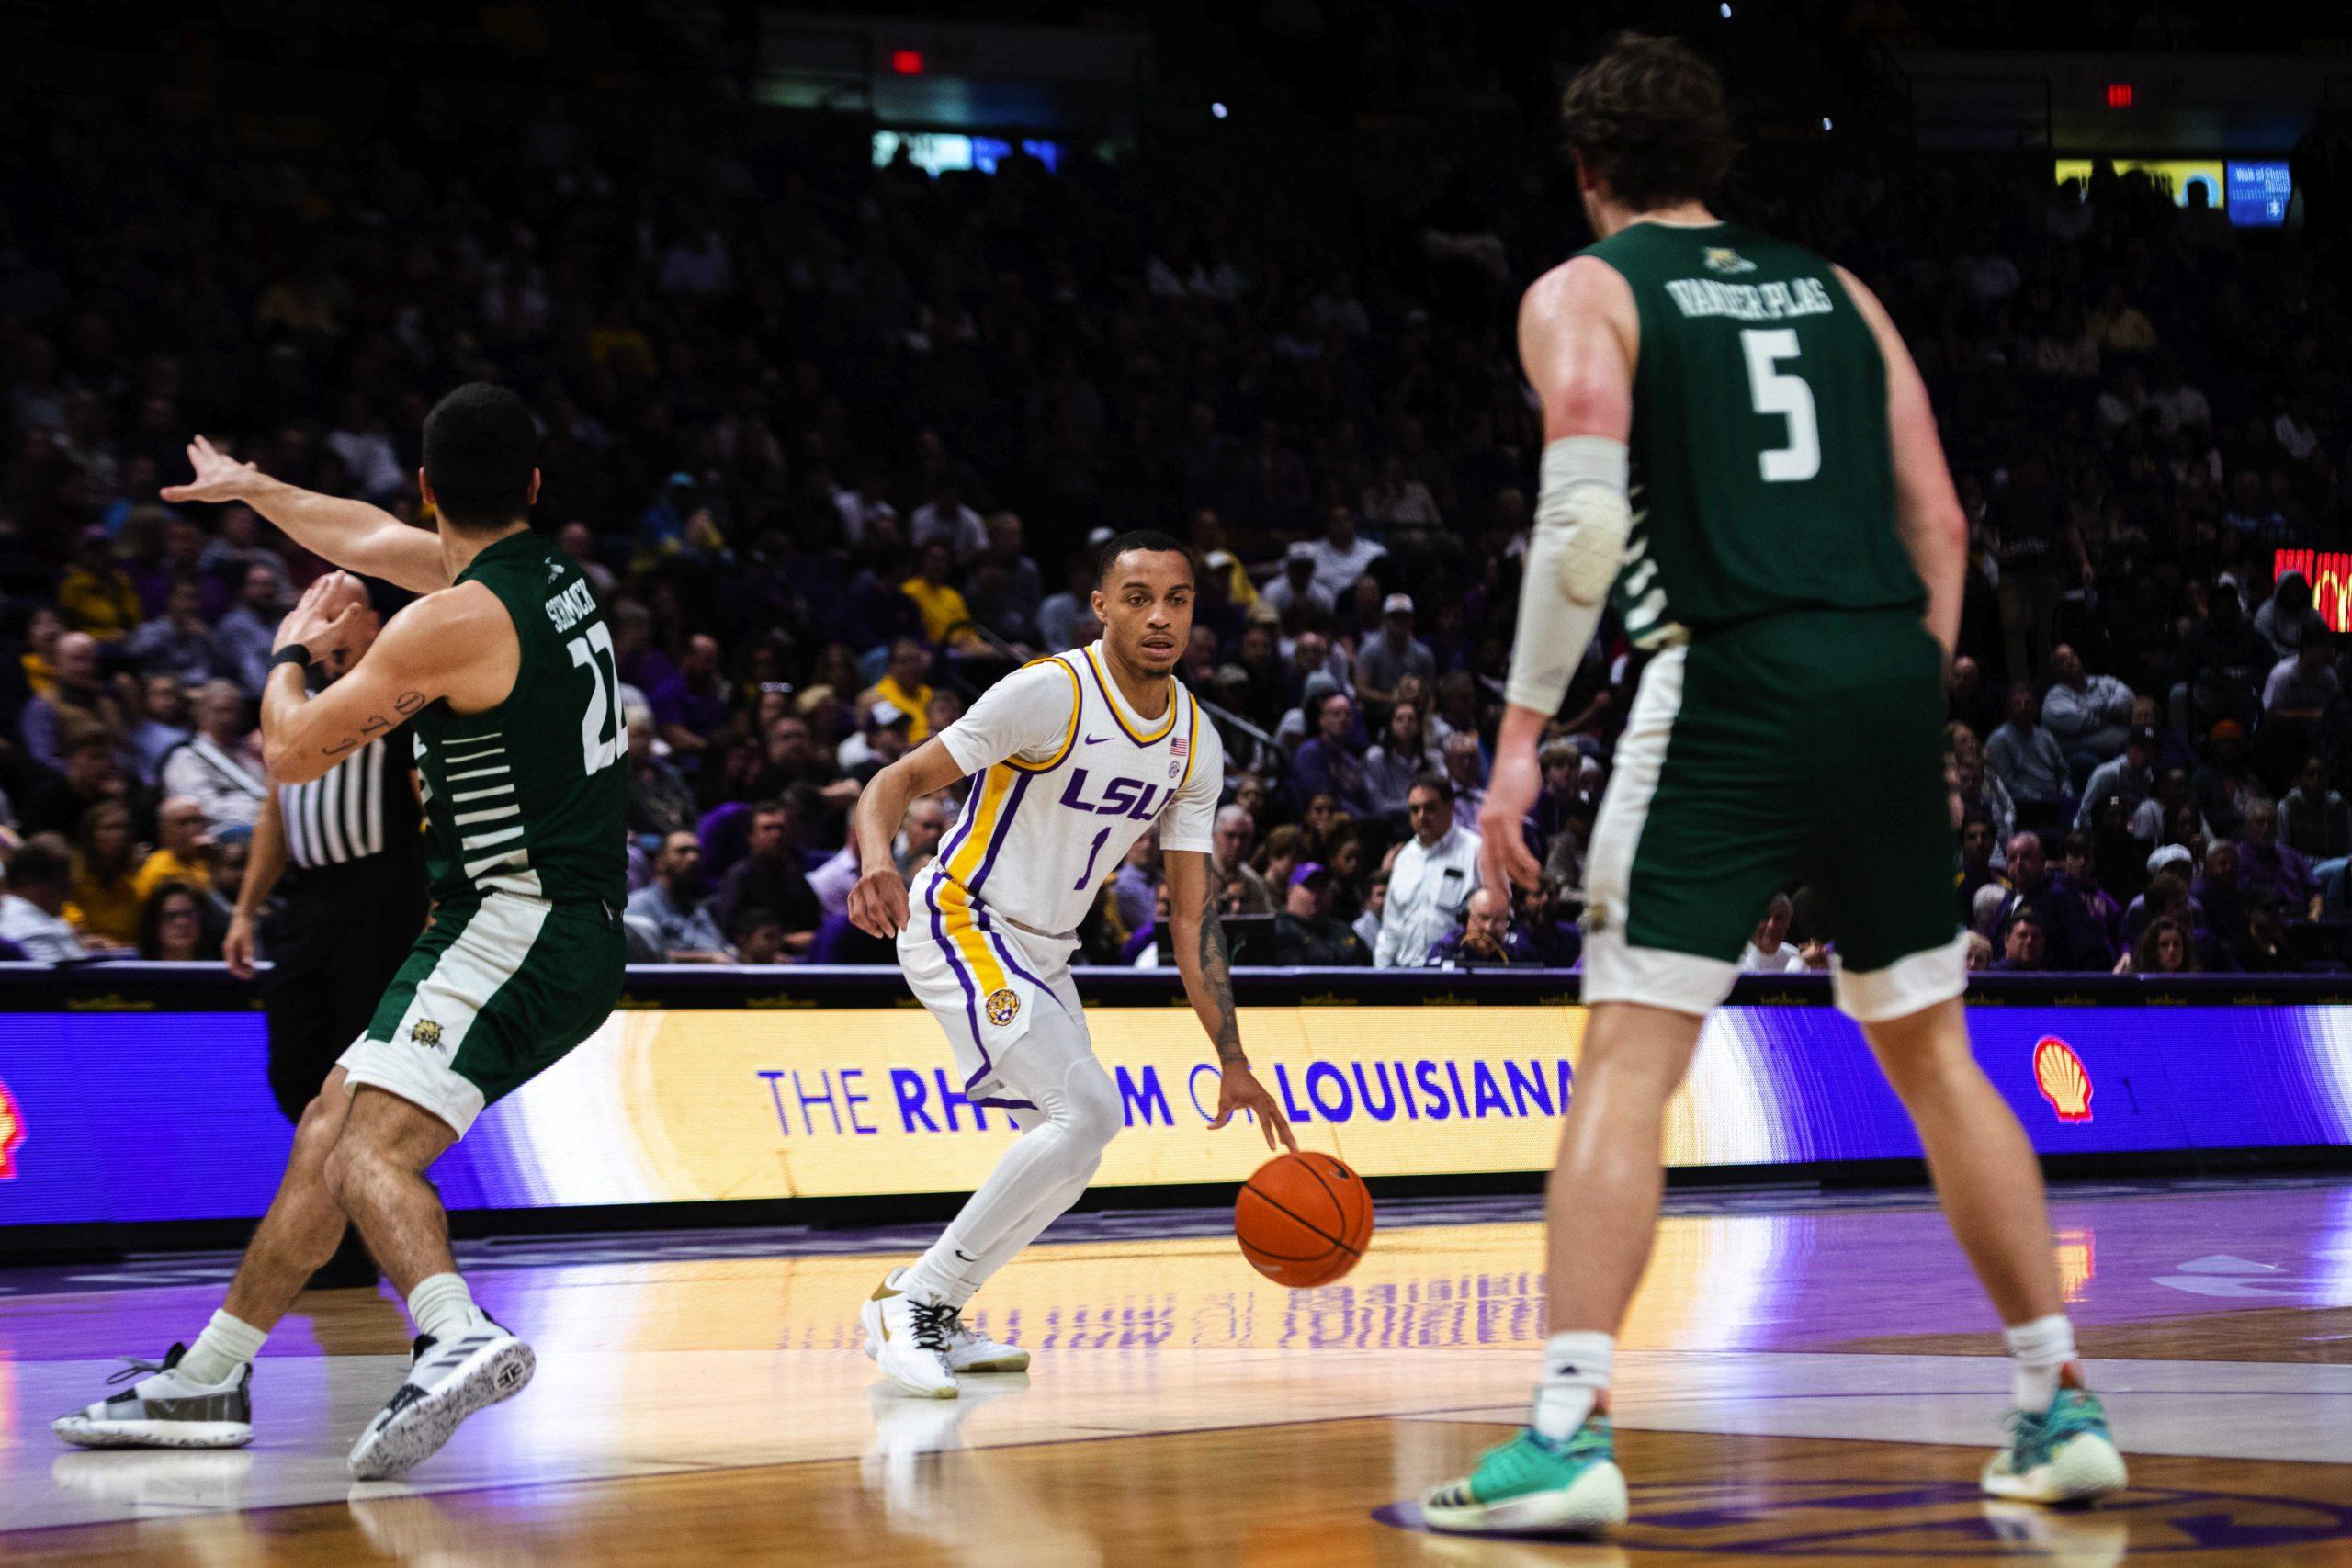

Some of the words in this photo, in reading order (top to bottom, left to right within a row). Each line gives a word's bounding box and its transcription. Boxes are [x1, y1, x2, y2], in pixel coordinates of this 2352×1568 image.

[1738, 328, 1822, 482] 5
[566, 620, 629, 776] 22
[1059, 767, 1176, 821] LSU
[1073, 827, 1112, 890] 1
[756, 1068, 877, 1136] THE
[889, 1064, 1174, 1134] RHM
[1188, 1063, 1253, 1124] O
